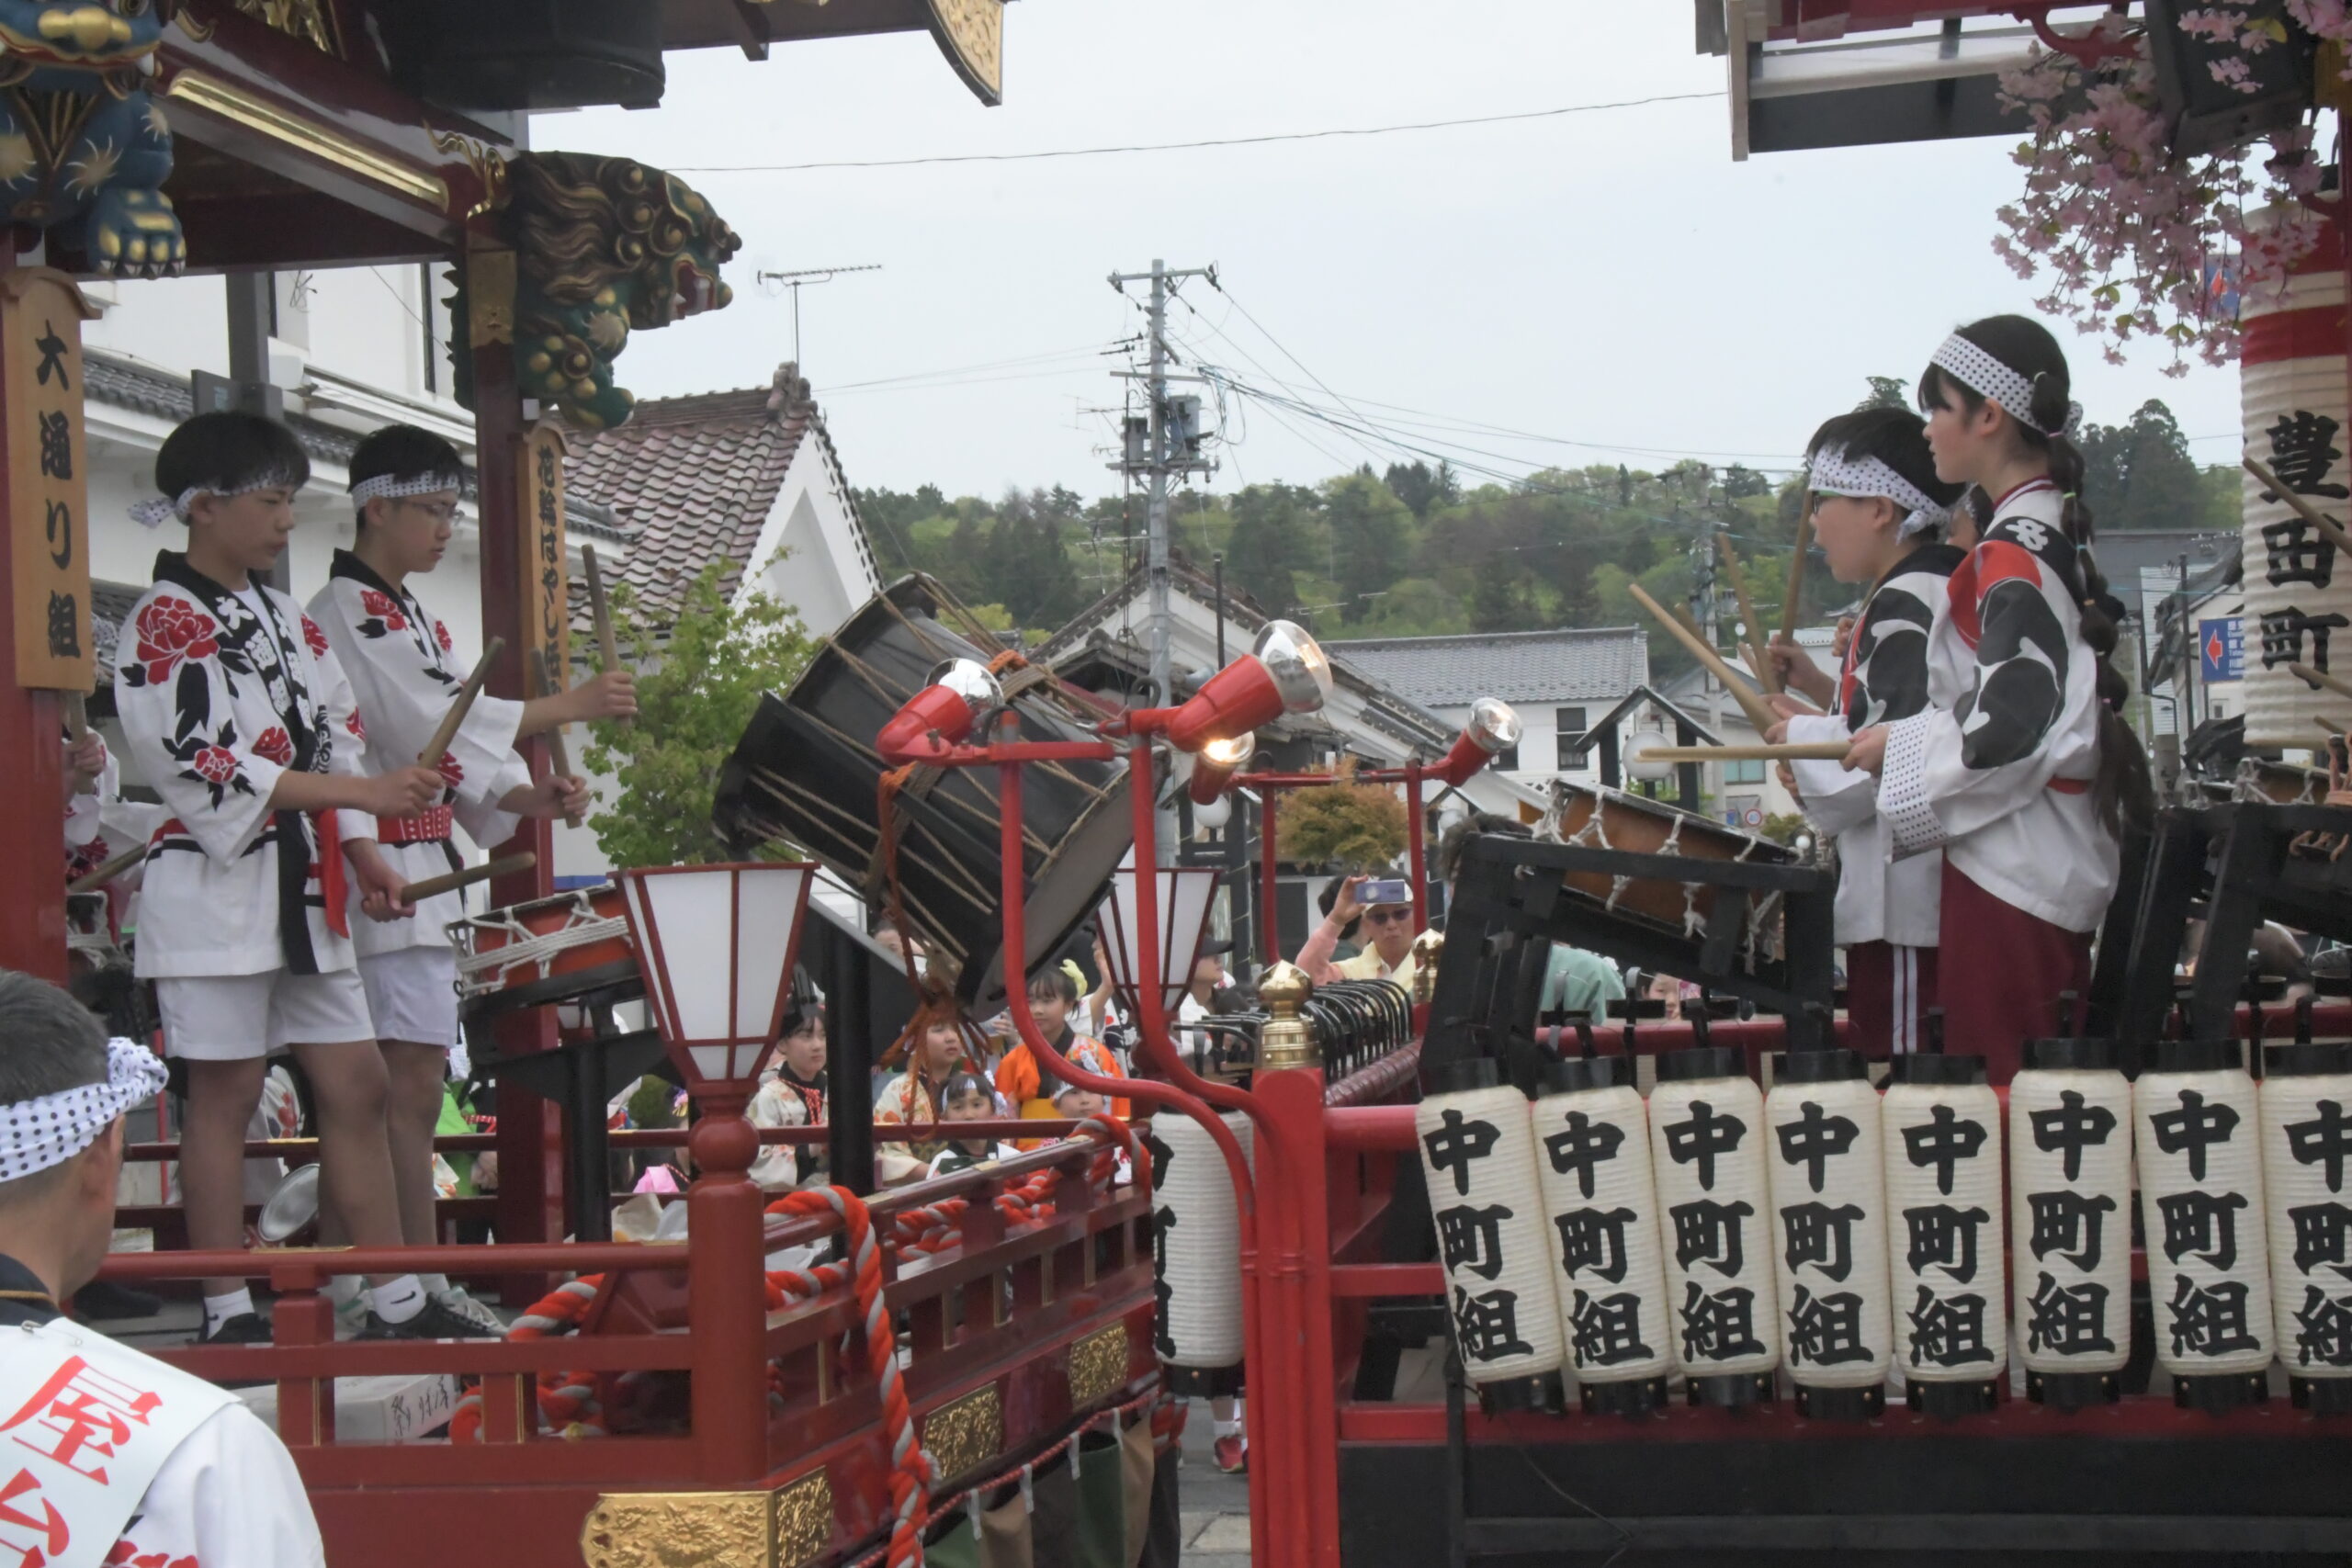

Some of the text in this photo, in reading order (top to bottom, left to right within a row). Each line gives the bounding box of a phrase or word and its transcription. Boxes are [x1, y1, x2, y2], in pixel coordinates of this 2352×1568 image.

[35, 319, 81, 658] 大通り組
[2259, 410, 2350, 691] 豊田町
[1423, 1109, 1533, 1363] 中町組
[1544, 1111, 1655, 1367] 中町組
[1663, 1100, 1767, 1366] 中町組
[1775, 1101, 1873, 1367] 中町組
[1901, 1105, 1995, 1367] 中町組
[2027, 1090, 2116, 1355] 中町組
[2149, 1089, 2261, 1357] 中町組
[2284, 1100, 2352, 1367] 中町組
